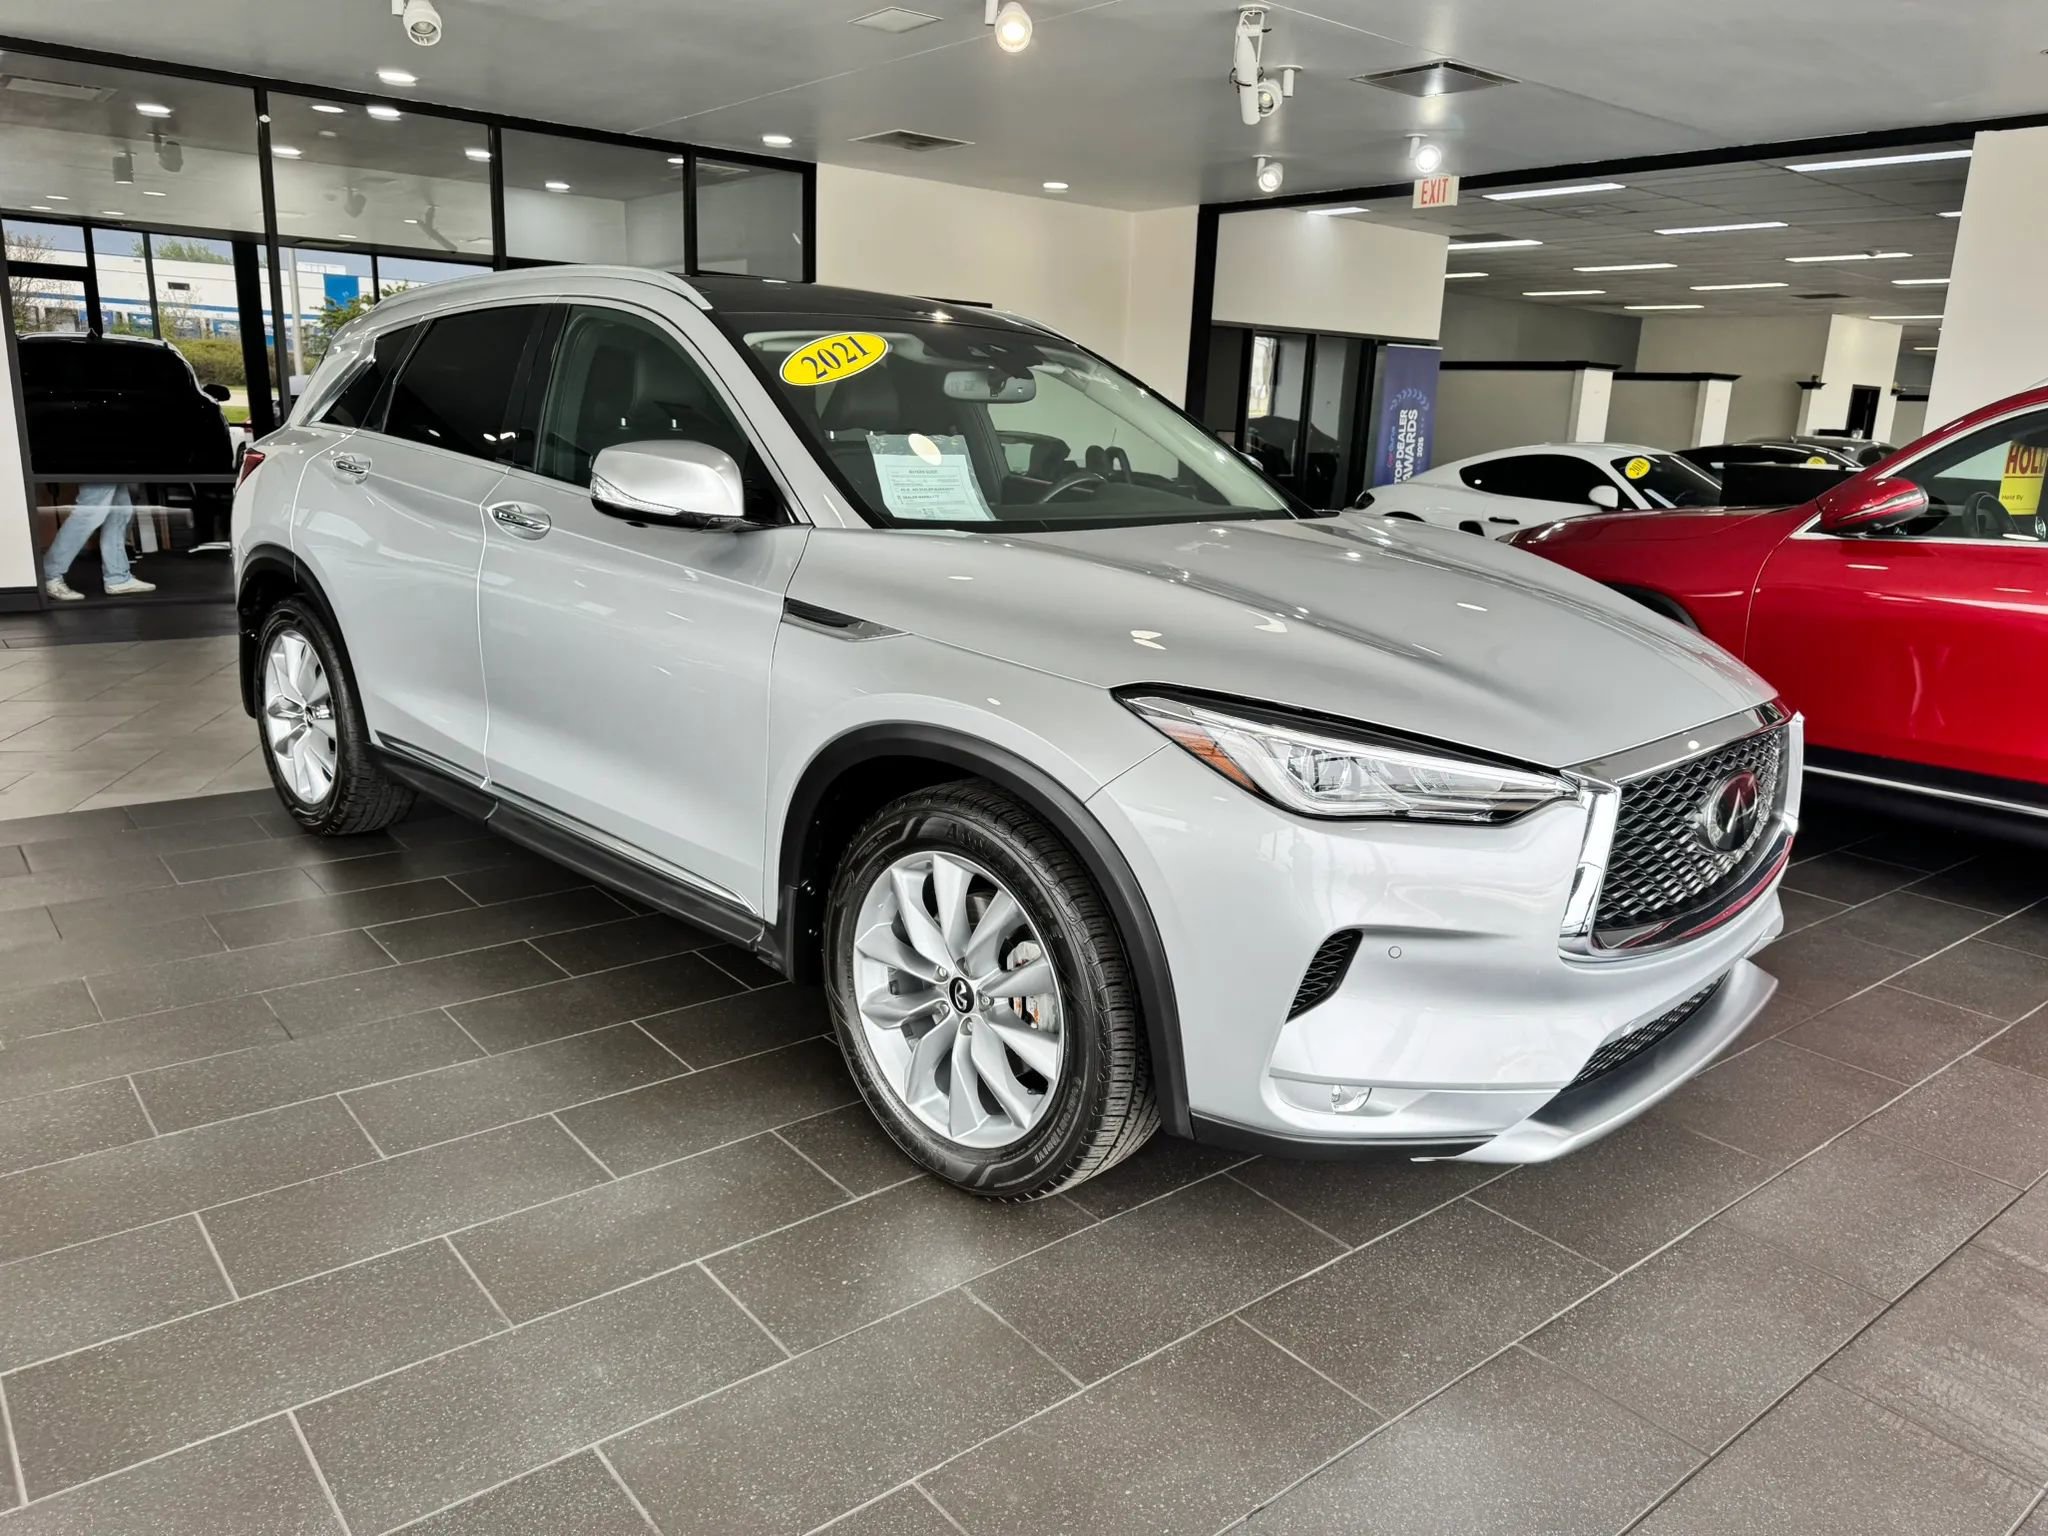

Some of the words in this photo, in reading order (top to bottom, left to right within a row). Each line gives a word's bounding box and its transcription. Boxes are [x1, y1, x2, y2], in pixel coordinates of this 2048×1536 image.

[1421, 178, 1448, 204] EXIT
[801, 336, 870, 379] 2021
[1396, 409, 1408, 459] DEALER
[1402, 409, 1418, 481] AWARDS
[1394, 460, 1402, 484] TOP
